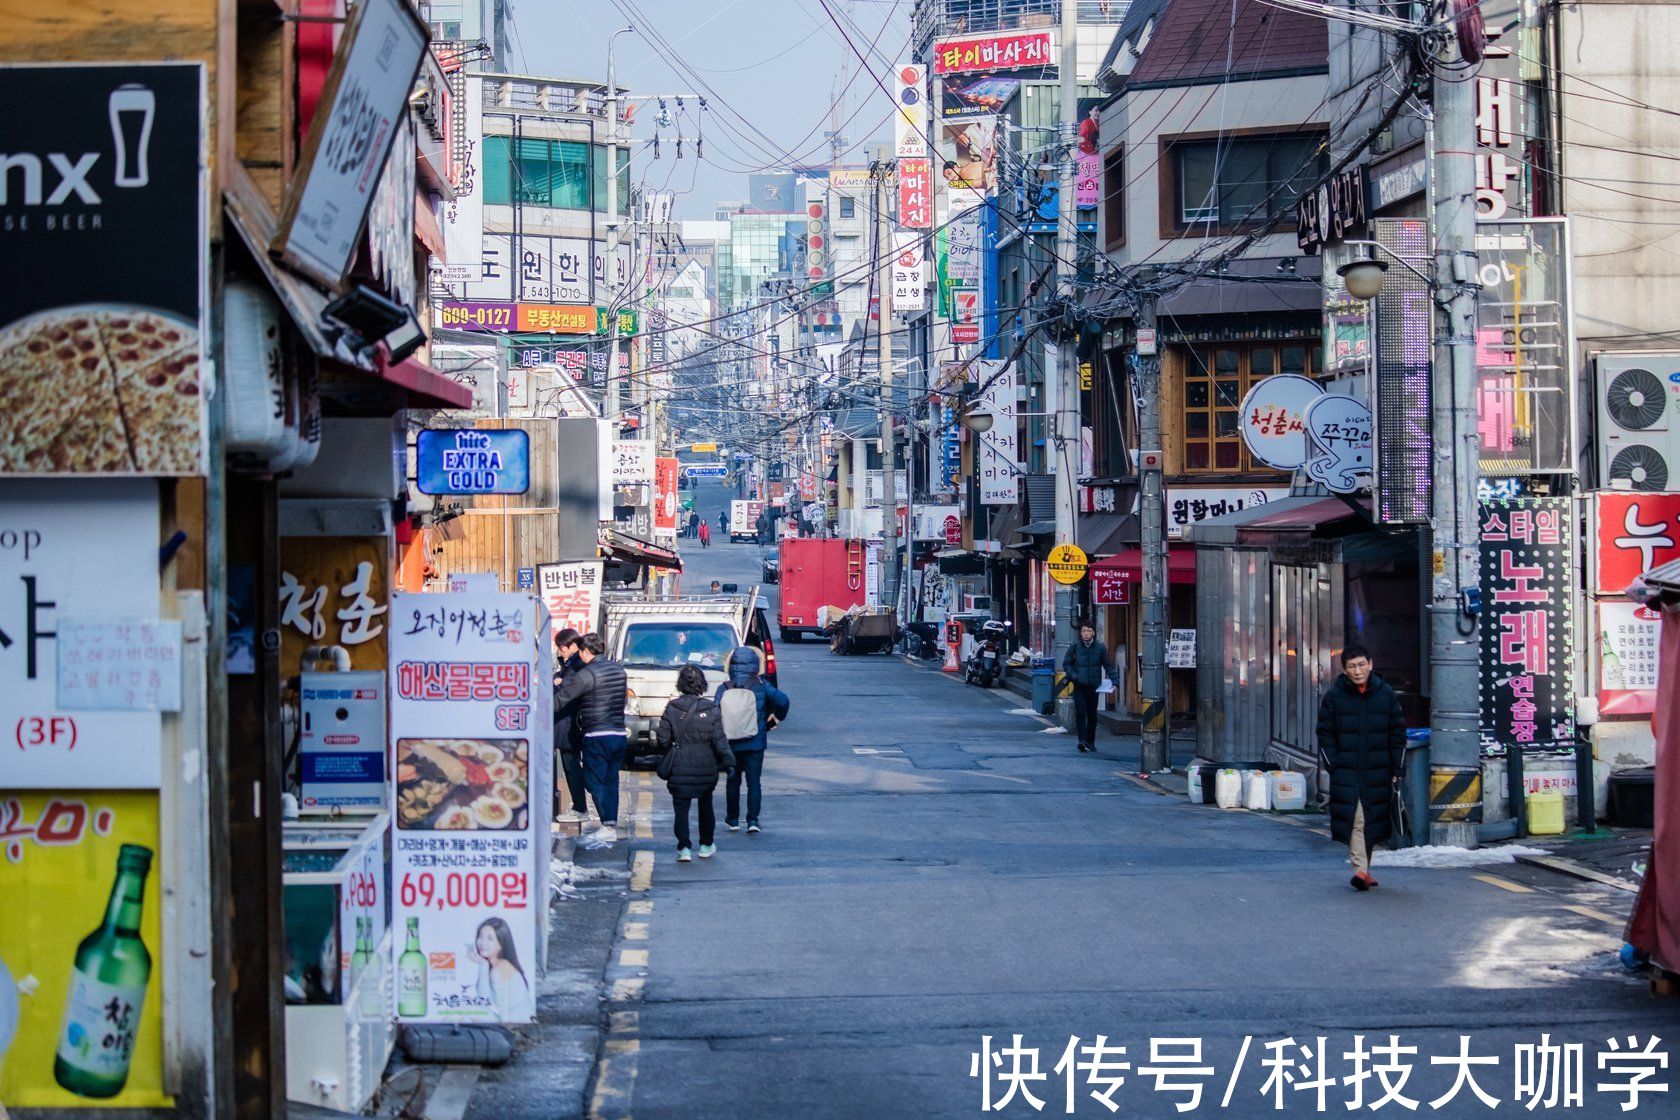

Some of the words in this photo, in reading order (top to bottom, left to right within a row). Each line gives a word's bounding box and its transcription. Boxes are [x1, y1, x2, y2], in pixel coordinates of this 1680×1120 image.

[47, 214, 101, 231] BEER
[445, 452, 501, 470] EXTRA
[450, 471, 496, 489] COLD
[1482, 510, 1560, 545] 스타일
[1103, 588, 1123, 600] 시간
[1494, 550, 1549, 675] 노래
[398, 662, 530, 700] 해산물몽땅!
[496, 706, 529, 730] SET
[1508, 675, 1538, 742] 연습장
[16, 717, 78, 750] (3F)
[401, 872, 527, 911] 69,000원
